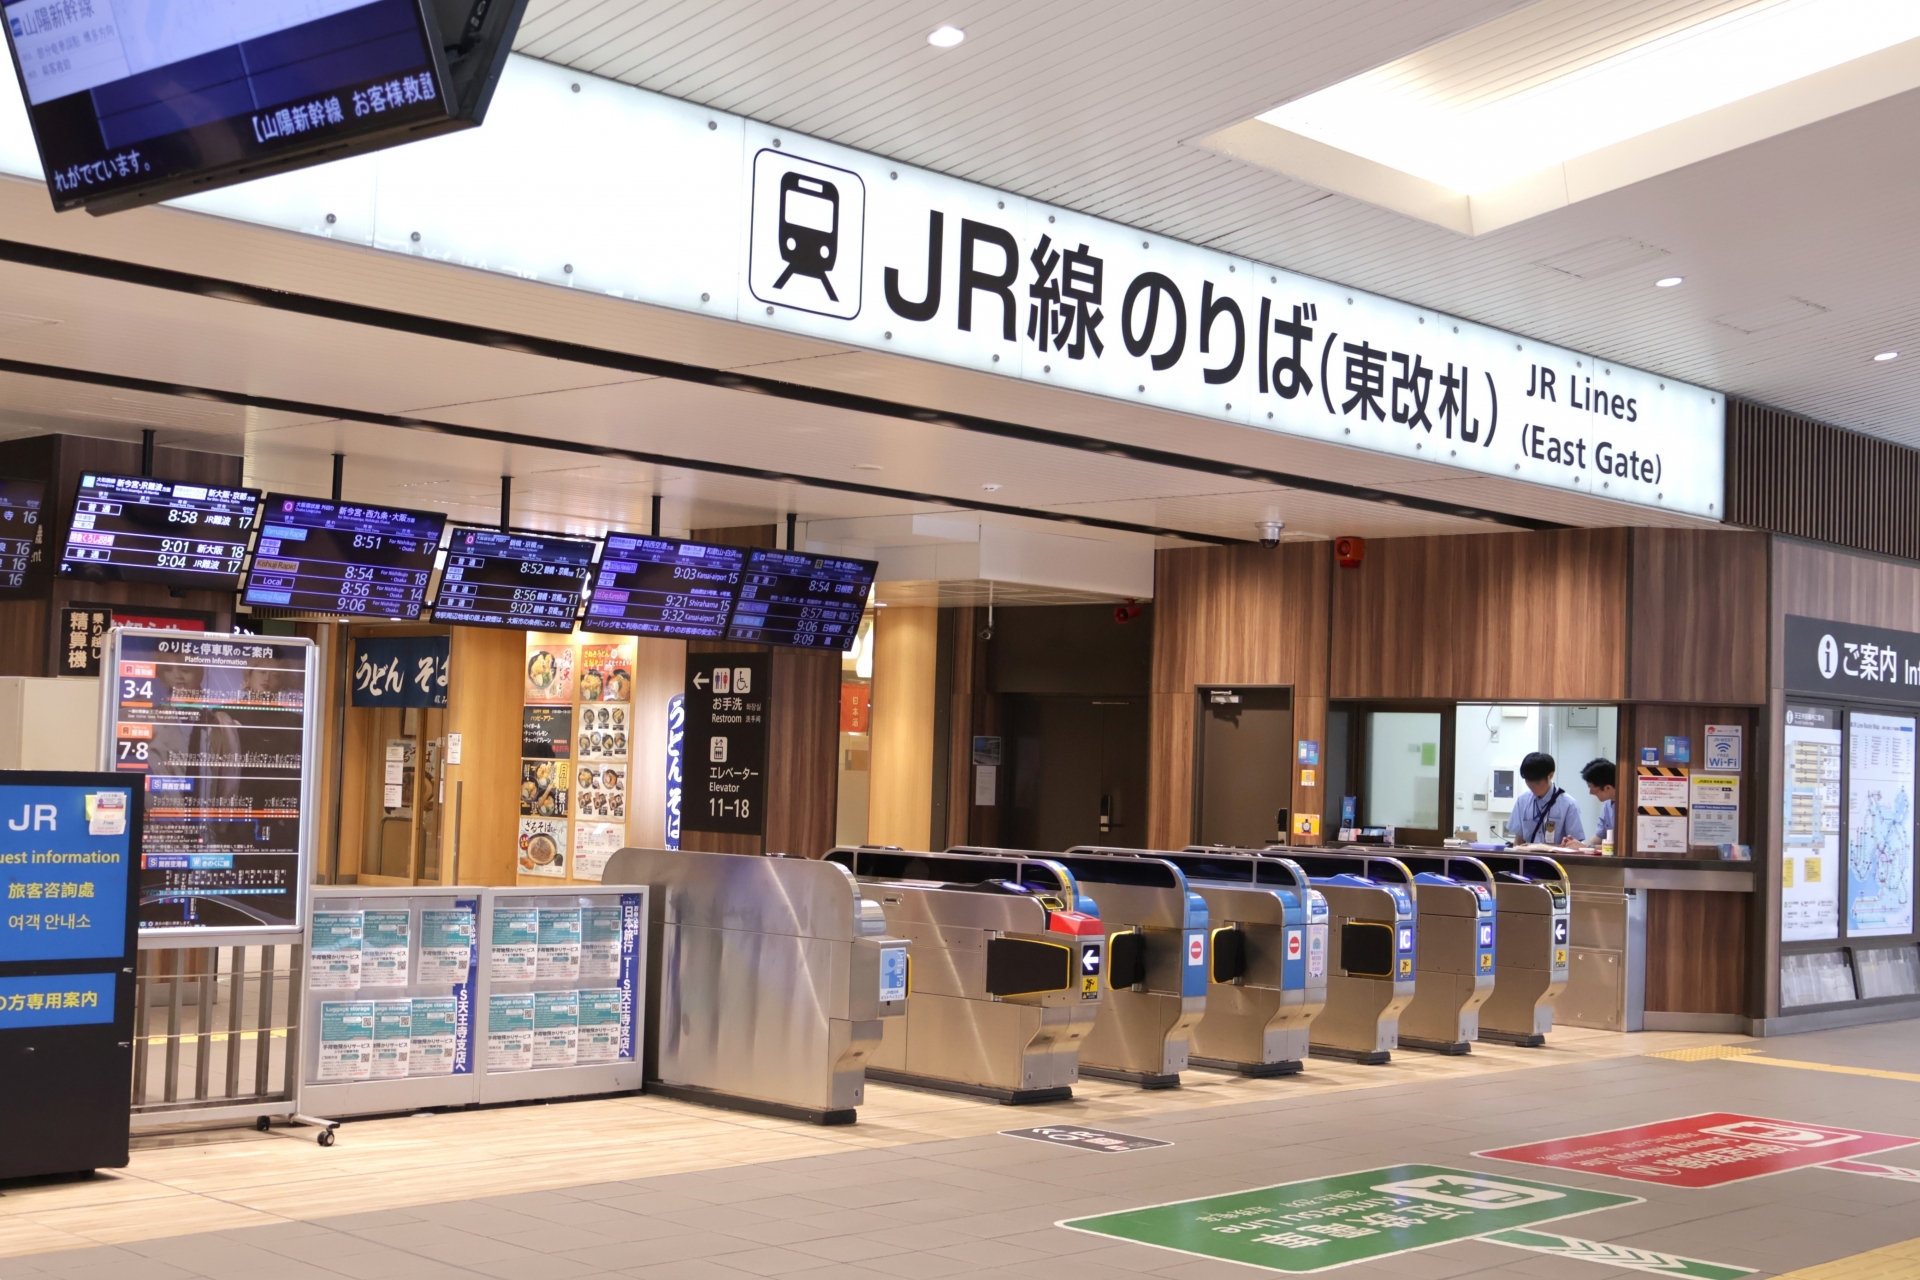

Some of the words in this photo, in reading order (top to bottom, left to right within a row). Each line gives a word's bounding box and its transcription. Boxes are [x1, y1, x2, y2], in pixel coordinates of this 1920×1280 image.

[54, 150, 151, 193] れがでています。
[1526, 363, 1557, 403] JR
[1570, 369, 1638, 424] Lines
[1521, 423, 1587, 469] (East
[1594, 441, 1663, 485] Gate)
[23, 511, 38, 524] 16
[167, 508, 198, 524] 8:58
[203, 514, 231, 526] JR難波
[237, 516, 252, 529] 17
[160, 538, 189, 554] 9:01
[353, 533, 382, 549] 8:51
[16, 542, 30, 555] 16
[196, 544, 223, 555] 新大阪
[230, 545, 244, 559] 18
[422, 541, 436, 555] 17
[12, 558, 26, 571] 16
[156, 553, 187, 568] 9:04
[192, 558, 219, 570] JR難波
[226, 560, 240, 573] 17
[255, 559, 278, 570] Kishuji
[277, 561, 296, 571] Rapid
[345, 565, 375, 581] 8:54
[520, 561, 544, 575] 8:52
[574, 567, 586, 579] 12
[673, 566, 697, 580] 9:03
[9, 574, 24, 586] 16
[262, 576, 283, 586] Local
[413, 572, 428, 586] 18
[696, 571, 727, 581] Kansai-airport
[727, 572, 739, 584] 15
[340, 581, 370, 596] 8:56
[808, 580, 831, 592] 8:54
[833, 584, 854, 594] 日根野
[859, 585, 867, 596] 8
[409, 588, 423, 601] 14
[513, 588, 537, 601] 8:56
[567, 593, 579, 604] 11
[665, 594, 688, 607] 9:21
[336, 597, 367, 612] 9:06
[405, 603, 419, 616] 18
[509, 601, 533, 614] 9:02
[688, 599, 719, 609] Shirahama
[719, 600, 731, 611] 15
[564, 606, 575, 618] 11
[661, 608, 685, 621] 9:32
[683, 613, 715, 623] Kansai-airport
[800, 607, 822, 618] 8:57
[849, 611, 860, 622] 15
[715, 613, 727, 625] 15
[796, 620, 819, 632] 9:06
[847, 624, 855, 635] 4
[68, 612, 88, 669] 精算機
[792, 633, 815, 645] 9:09
[843, 638, 851, 648] 8
[158, 640, 273, 659] のりばと停車駅のご案内
[184, 656, 212, 665] Platform
[212, 656, 247, 666] Information
[1843, 642, 1897, 683] ご案内
[712, 697, 743, 712] お手洗
[712, 713, 742, 724] Restroom
[1709, 758, 1737, 767] Wi-Fi
[710, 767, 758, 780] エレベーター
[709, 782, 740, 793] Elevator
[8, 804, 58, 831] JR
[31, 850, 120, 864] information
[8, 882, 95, 899] 旅客咨詢處
[8, 914, 41, 931] 여객
[44, 913, 91, 930] 안내소
[1400, 930, 1411, 950] IC
[1480, 927, 1491, 945] IC
[1571, 1156, 1612, 1166] Line
[1287, 1196, 1411, 1225] Kintetsu
[1211, 1214, 1295, 1235] Line
[1250, 1203, 1475, 1249] 近鉄電車
